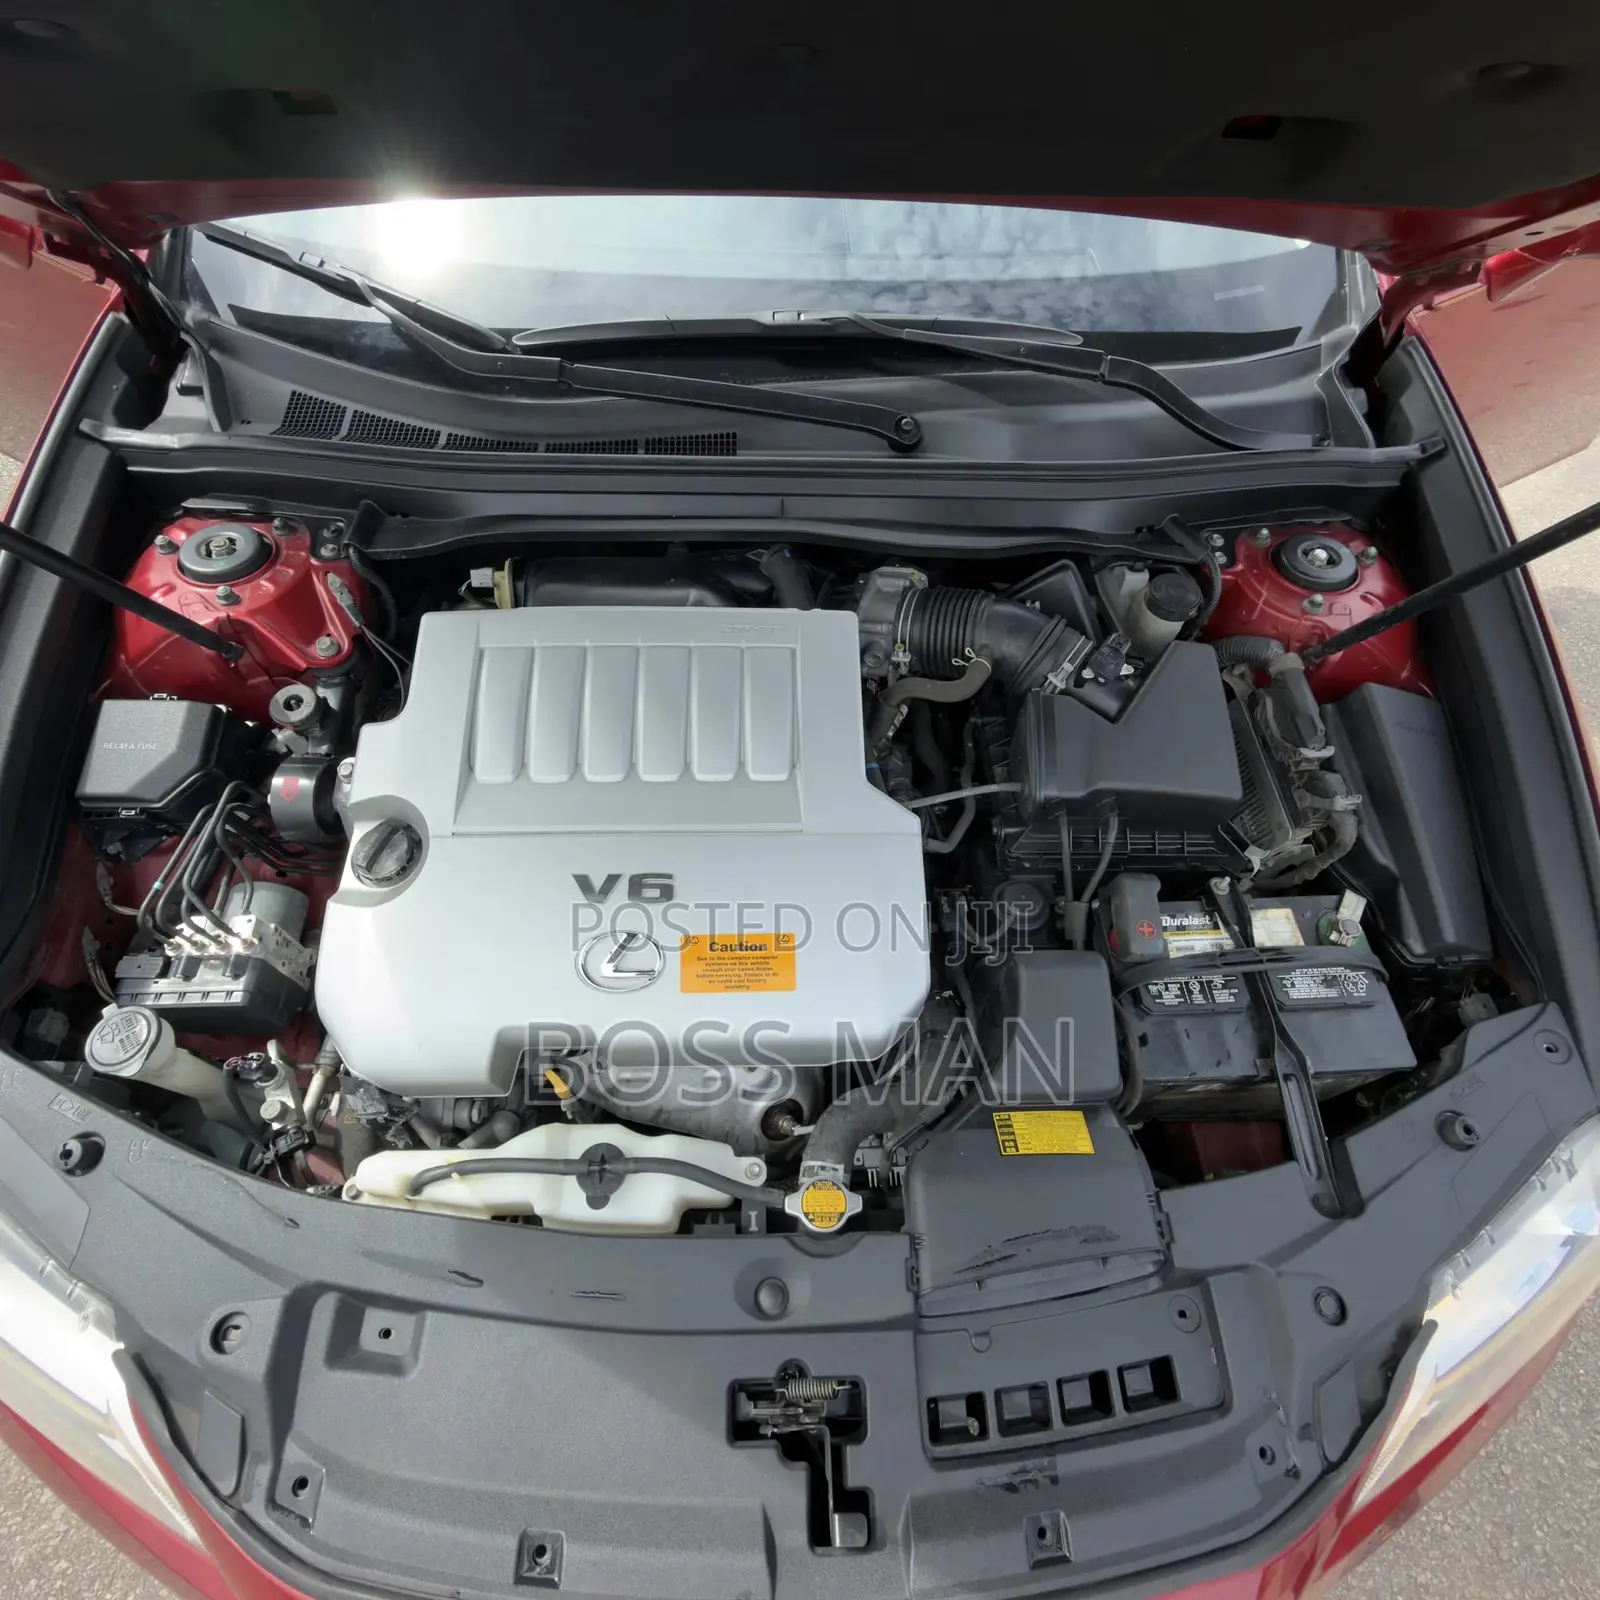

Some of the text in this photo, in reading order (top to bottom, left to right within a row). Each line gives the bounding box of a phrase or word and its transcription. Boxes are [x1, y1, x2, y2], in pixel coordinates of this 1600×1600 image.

[571, 873, 676, 904] V6
[1160, 915, 1211, 926] Duralast
[709, 941, 768, 952] Caution
